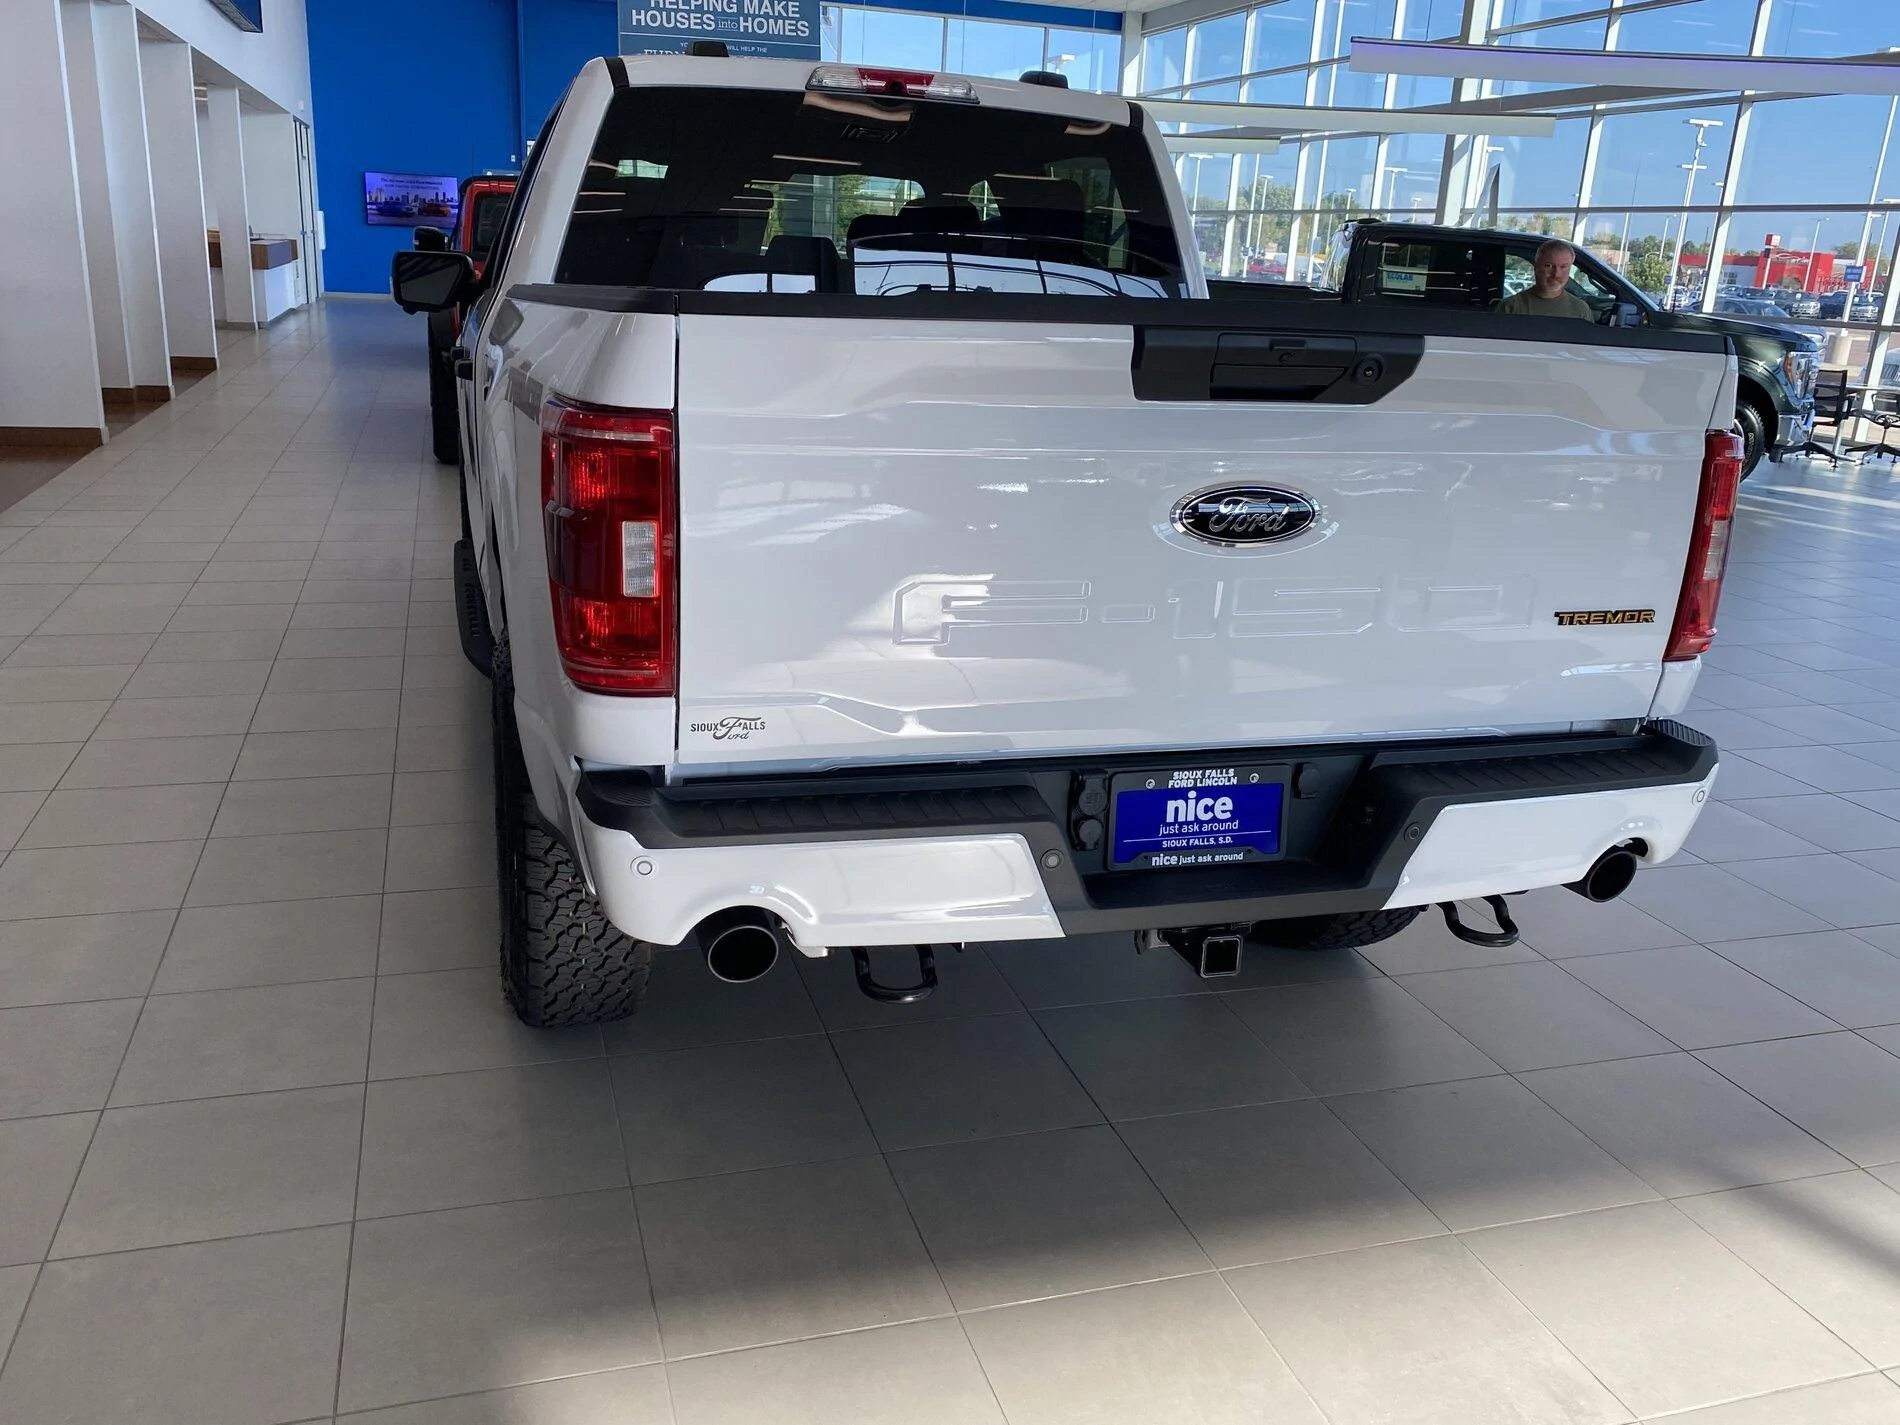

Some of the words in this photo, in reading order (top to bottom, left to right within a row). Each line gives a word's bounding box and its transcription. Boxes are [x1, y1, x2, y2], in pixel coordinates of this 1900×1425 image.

[651, 0, 737, 13] HELPING
[744, 0, 800, 17] MAKE
[632, 10, 716, 30] HOUSES
[718, 19, 738, 30] into
[739, 17, 809, 37] HOMES
[1208, 496, 1290, 533] Ford
[1554, 609, 1656, 625] TREMOR
[690, 723, 719, 732] SIOUX
[1168, 778, 1195, 788] FORD
[1197, 777, 1237, 787] LINCOLN
[1173, 771, 1203, 780] SIOUX
[1205, 769, 1235, 778] FALLS
[1166, 790, 1233, 822] nice
[1159, 823, 1179, 836] just
[1182, 822, 1199, 832] ask
[1202, 820, 1239, 831] around
[1162, 839, 1187, 848] SIOUX
[1189, 837, 1216, 846] FALLS,
[1218, 836, 1233, 844] S.D.
[1152, 853, 1178, 866] nice
[1178, 855, 1195, 865] just
[1197, 854, 1212, 863] ask
[1215, 852, 1243, 861] around
